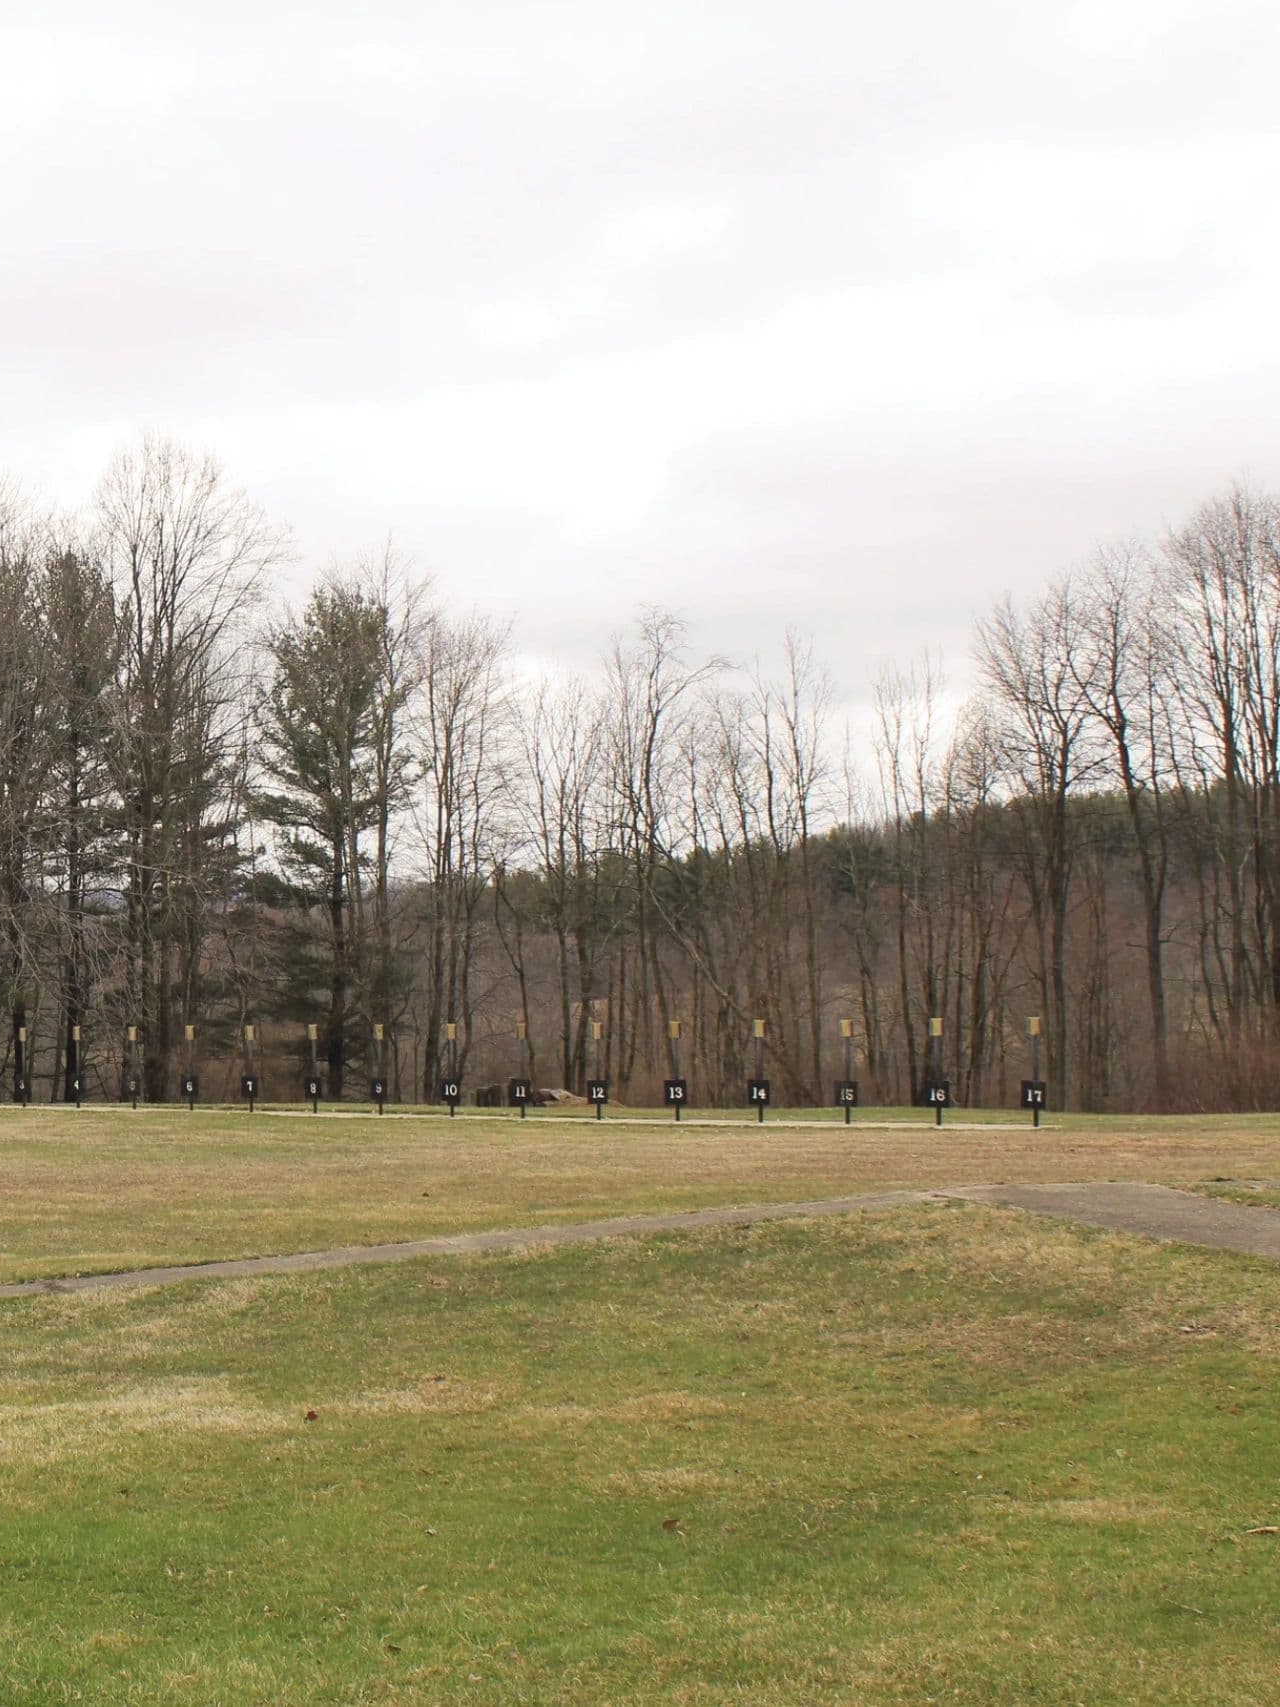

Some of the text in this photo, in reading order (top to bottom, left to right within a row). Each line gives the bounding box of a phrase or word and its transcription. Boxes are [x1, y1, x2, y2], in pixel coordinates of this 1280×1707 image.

[73, 1080, 79, 1090] 4
[186, 1081, 193, 1091] 6
[310, 1083, 317, 1094] 8
[445, 1084, 458, 1096] 10
[515, 1086, 526, 1097] 11
[592, 1087, 605, 1098] 12
[669, 1087, 683, 1099] 13
[752, 1087, 766, 1099] 14
[840, 1089, 853, 1101] 15
[930, 1089, 945, 1102] 16
[1027, 1090, 1042, 1102] 17
